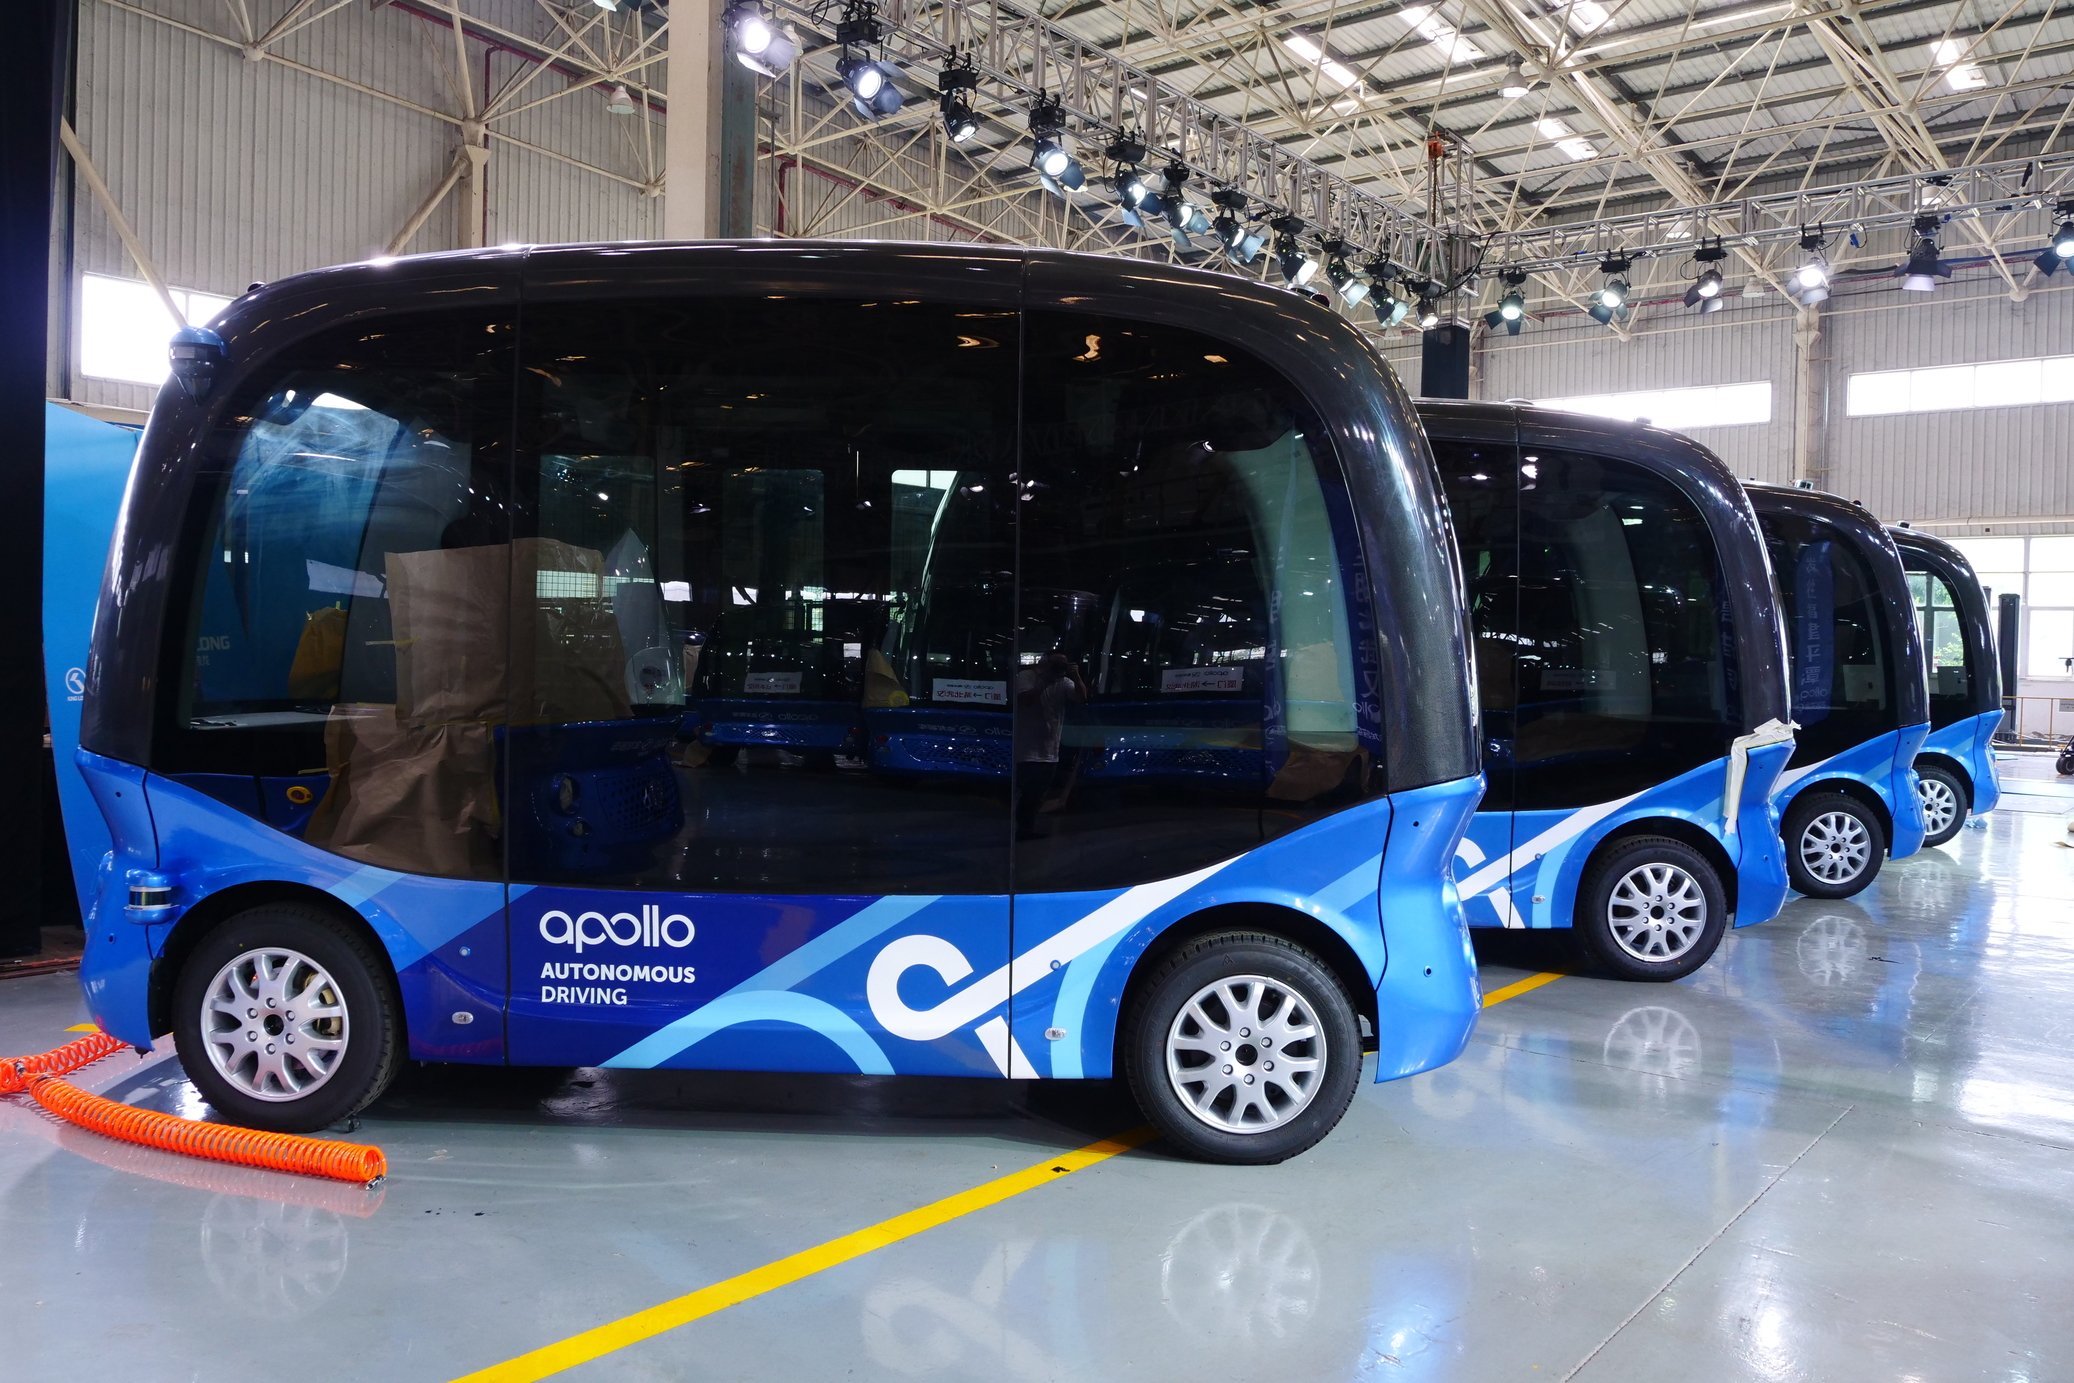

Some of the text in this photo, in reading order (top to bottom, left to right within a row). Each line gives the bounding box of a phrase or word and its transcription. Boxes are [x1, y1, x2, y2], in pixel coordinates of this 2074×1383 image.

[539, 904, 696, 953] apollo
[541, 962, 696, 984] AUTONOMOUS
[541, 986, 628, 1005] DRIVING
